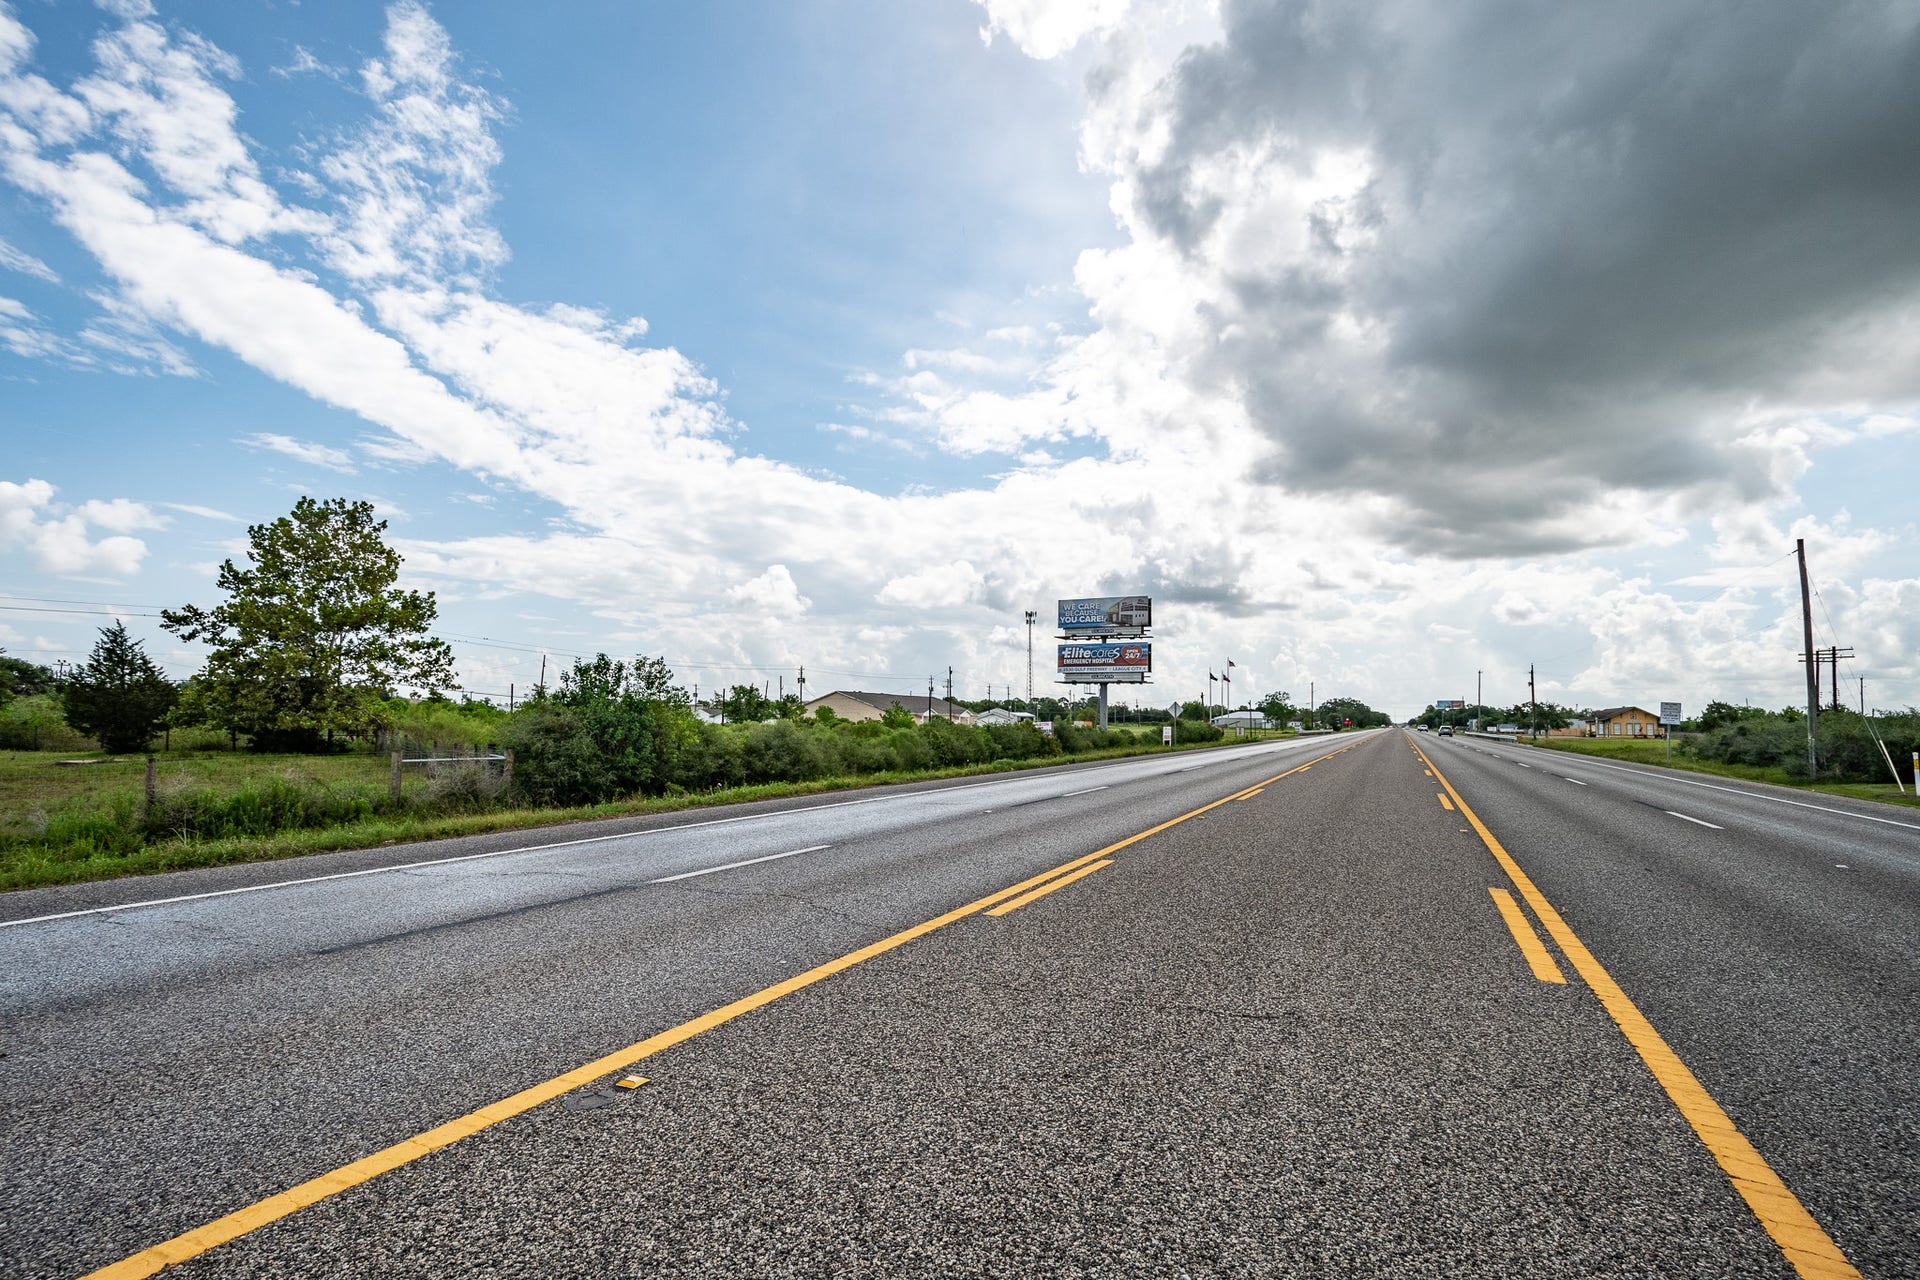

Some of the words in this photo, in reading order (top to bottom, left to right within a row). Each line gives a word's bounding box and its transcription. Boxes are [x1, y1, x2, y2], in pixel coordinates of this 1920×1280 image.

[1063, 603, 1077, 611] WE
[1078, 602, 1100, 610] CARE
[1065, 609, 1098, 617] BECAUSE
[1060, 616, 1077, 624] YOU
[1079, 615, 1105, 623] CARE!
